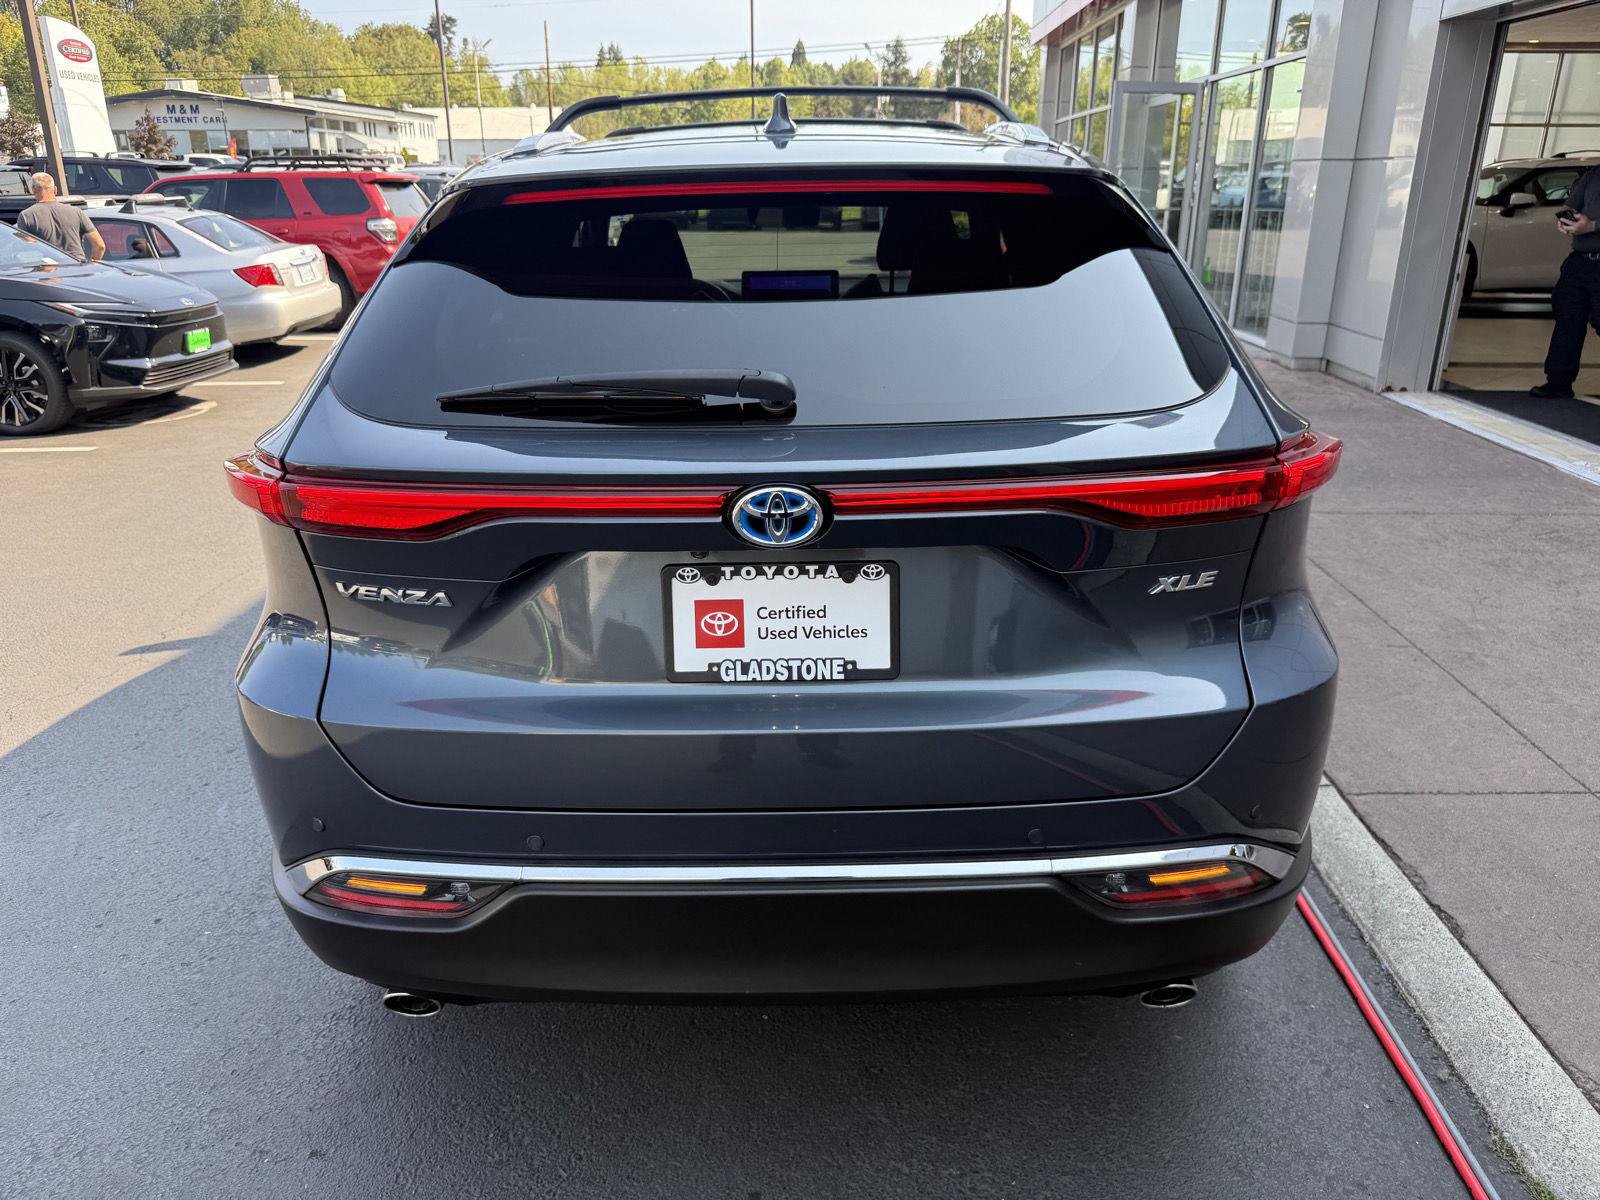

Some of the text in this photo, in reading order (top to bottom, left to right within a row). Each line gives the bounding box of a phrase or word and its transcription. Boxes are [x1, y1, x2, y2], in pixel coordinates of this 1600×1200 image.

[59, 69, 100, 83] USED VEHICLES
[166, 104, 200, 114] M & M
[721, 564, 839, 580] TOYOTA
[1148, 570, 1219, 595] XLE
[335, 581, 453, 607] VENZA
[757, 605, 827, 620] Certified
[757, 625, 868, 640] Used Vehicles
[720, 658, 845, 682] GLADSTONE
